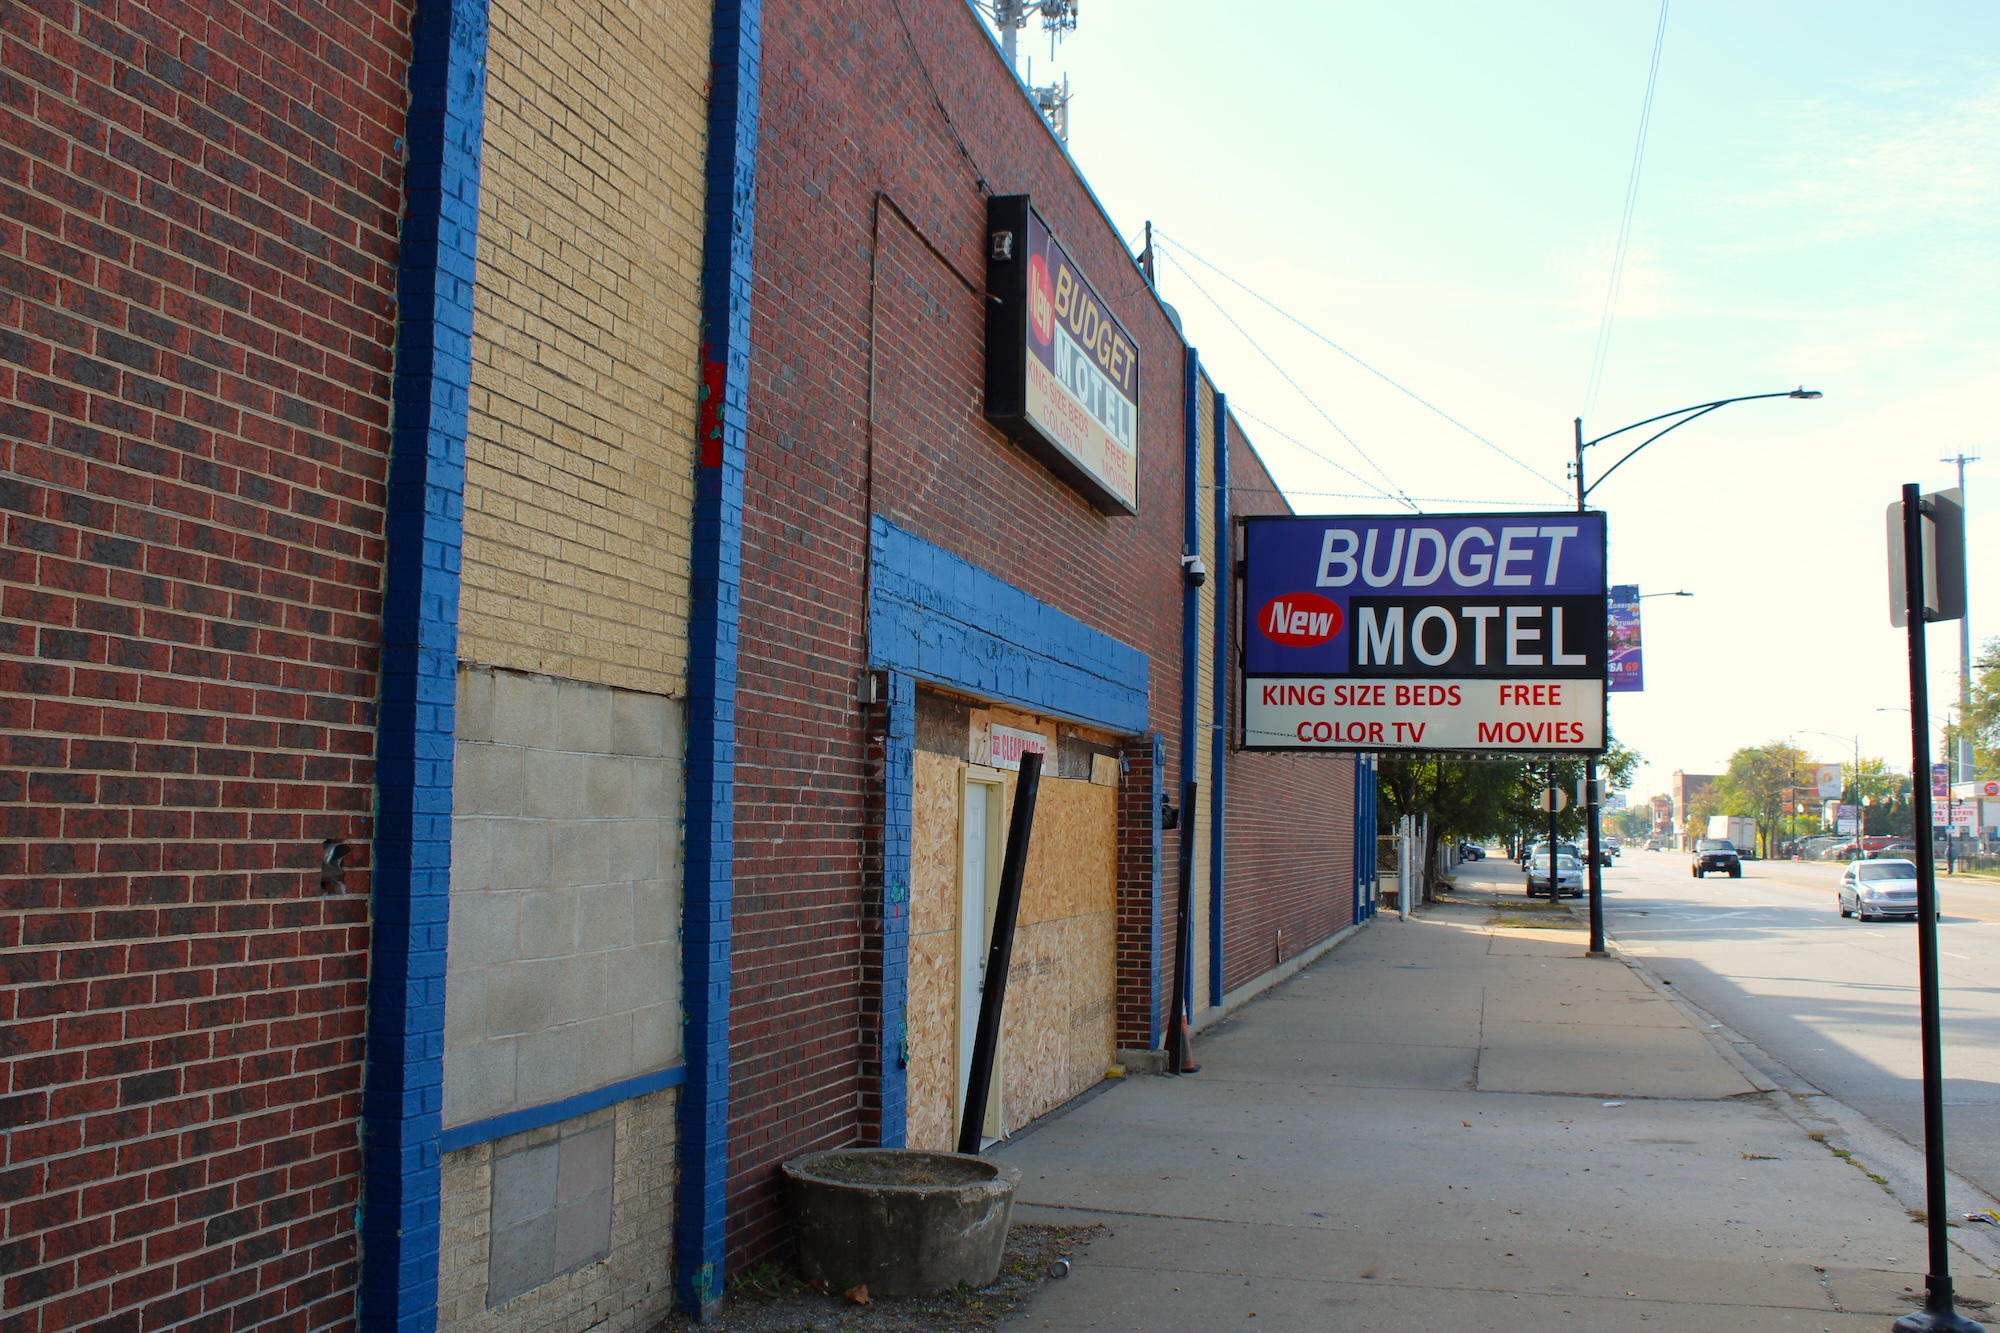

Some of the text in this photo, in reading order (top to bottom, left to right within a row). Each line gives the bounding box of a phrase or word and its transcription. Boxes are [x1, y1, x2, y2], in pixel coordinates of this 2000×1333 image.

[1030, 264, 1052, 340] New
[1054, 263, 1135, 391] BUDGET
[1028, 358, 1089, 438] KING SIZE BEDS
[1056, 332, 1129, 444] MOTEL
[1043, 405, 1083, 457] COLOR TV
[1105, 438, 1128, 473] FREE
[1101, 459, 1134, 501] MOVIES
[1315, 526, 1579, 588] BUDGET
[1268, 601, 1333, 637] New
[1358, 605, 1587, 667] MOTEL
[1607, 661, 1639, 672] SA 69
[1262, 685, 1462, 706] KING SIZE BEDS
[1500, 685, 1561, 706] FREE
[1297, 721, 1426, 744] COLOR TV
[1478, 721, 1584, 744] MOVIES
[1987, 785, 1998, 793] 76
